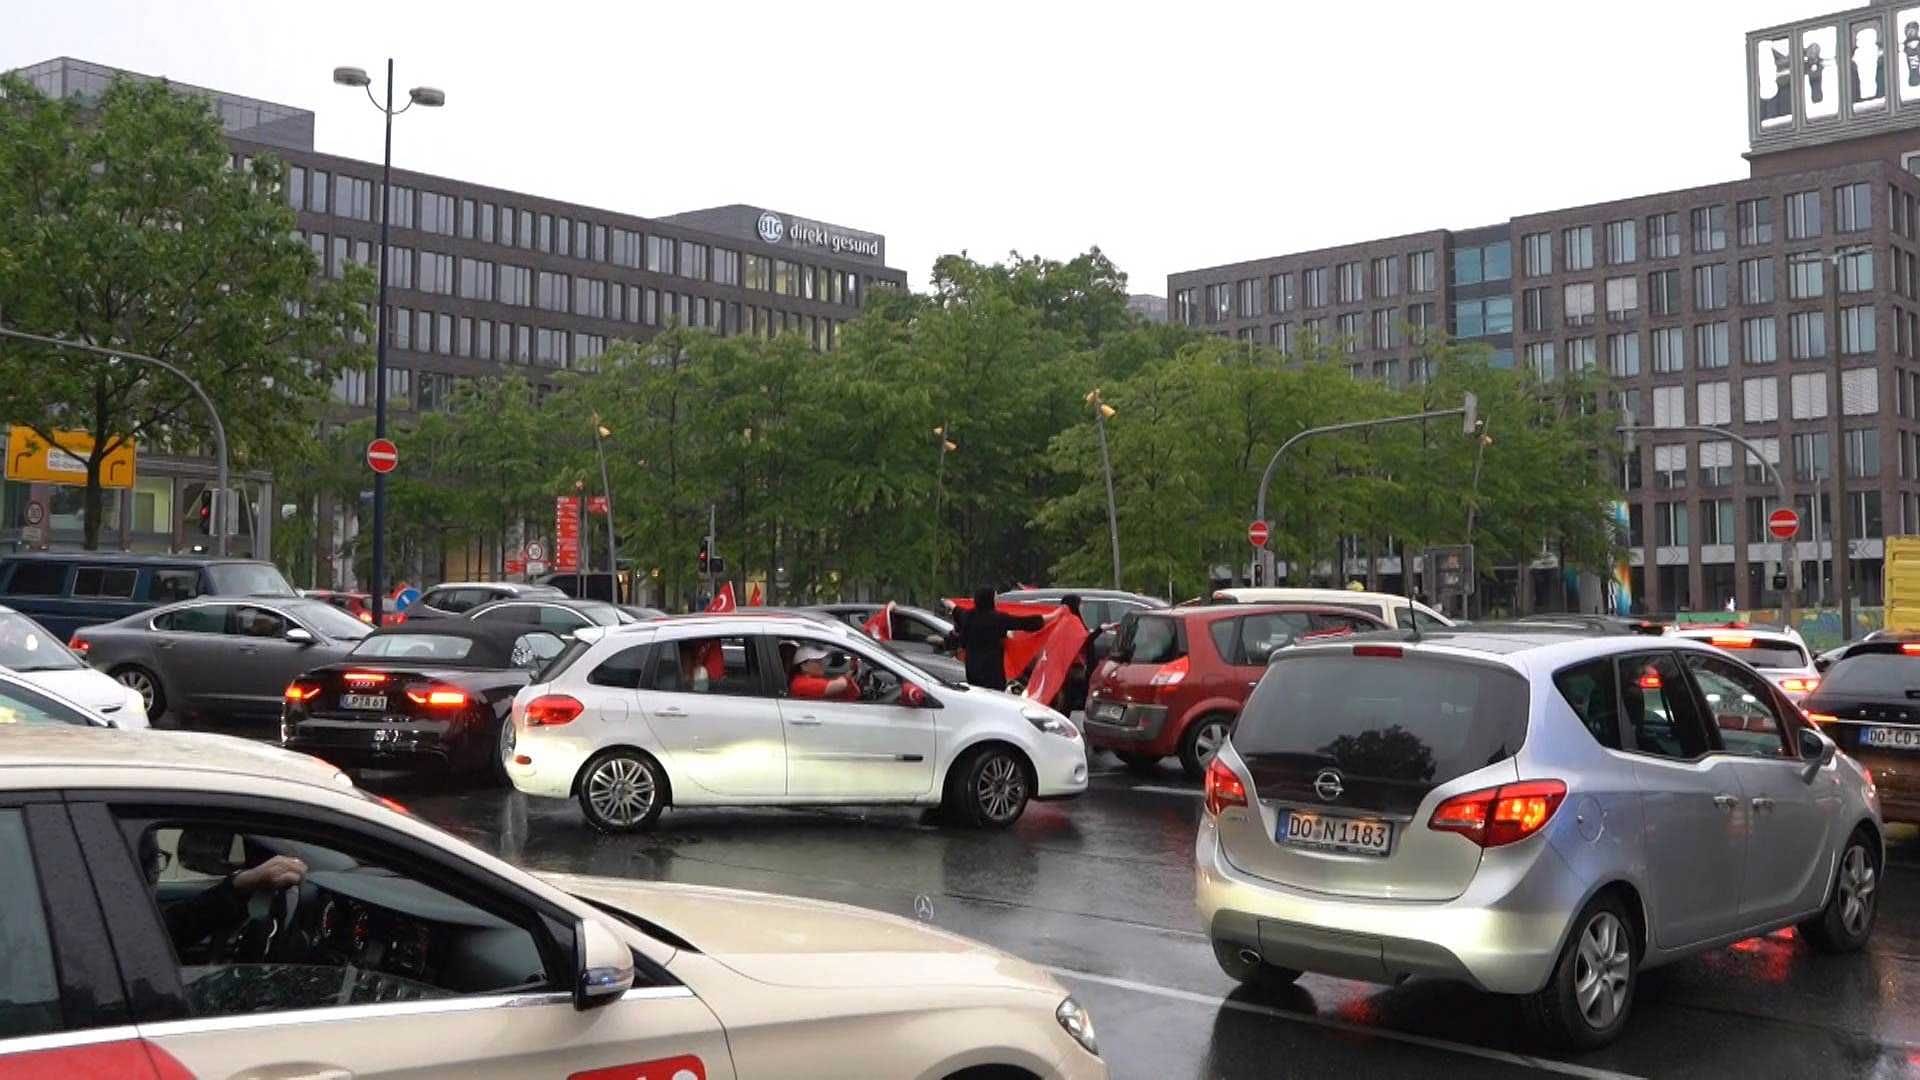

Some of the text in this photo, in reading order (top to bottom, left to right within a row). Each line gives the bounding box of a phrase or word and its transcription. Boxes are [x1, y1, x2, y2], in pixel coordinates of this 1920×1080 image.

[790, 223, 828, 246] direkt
[832, 235, 879, 256] gesund
[1289, 817, 1312, 838] DO
